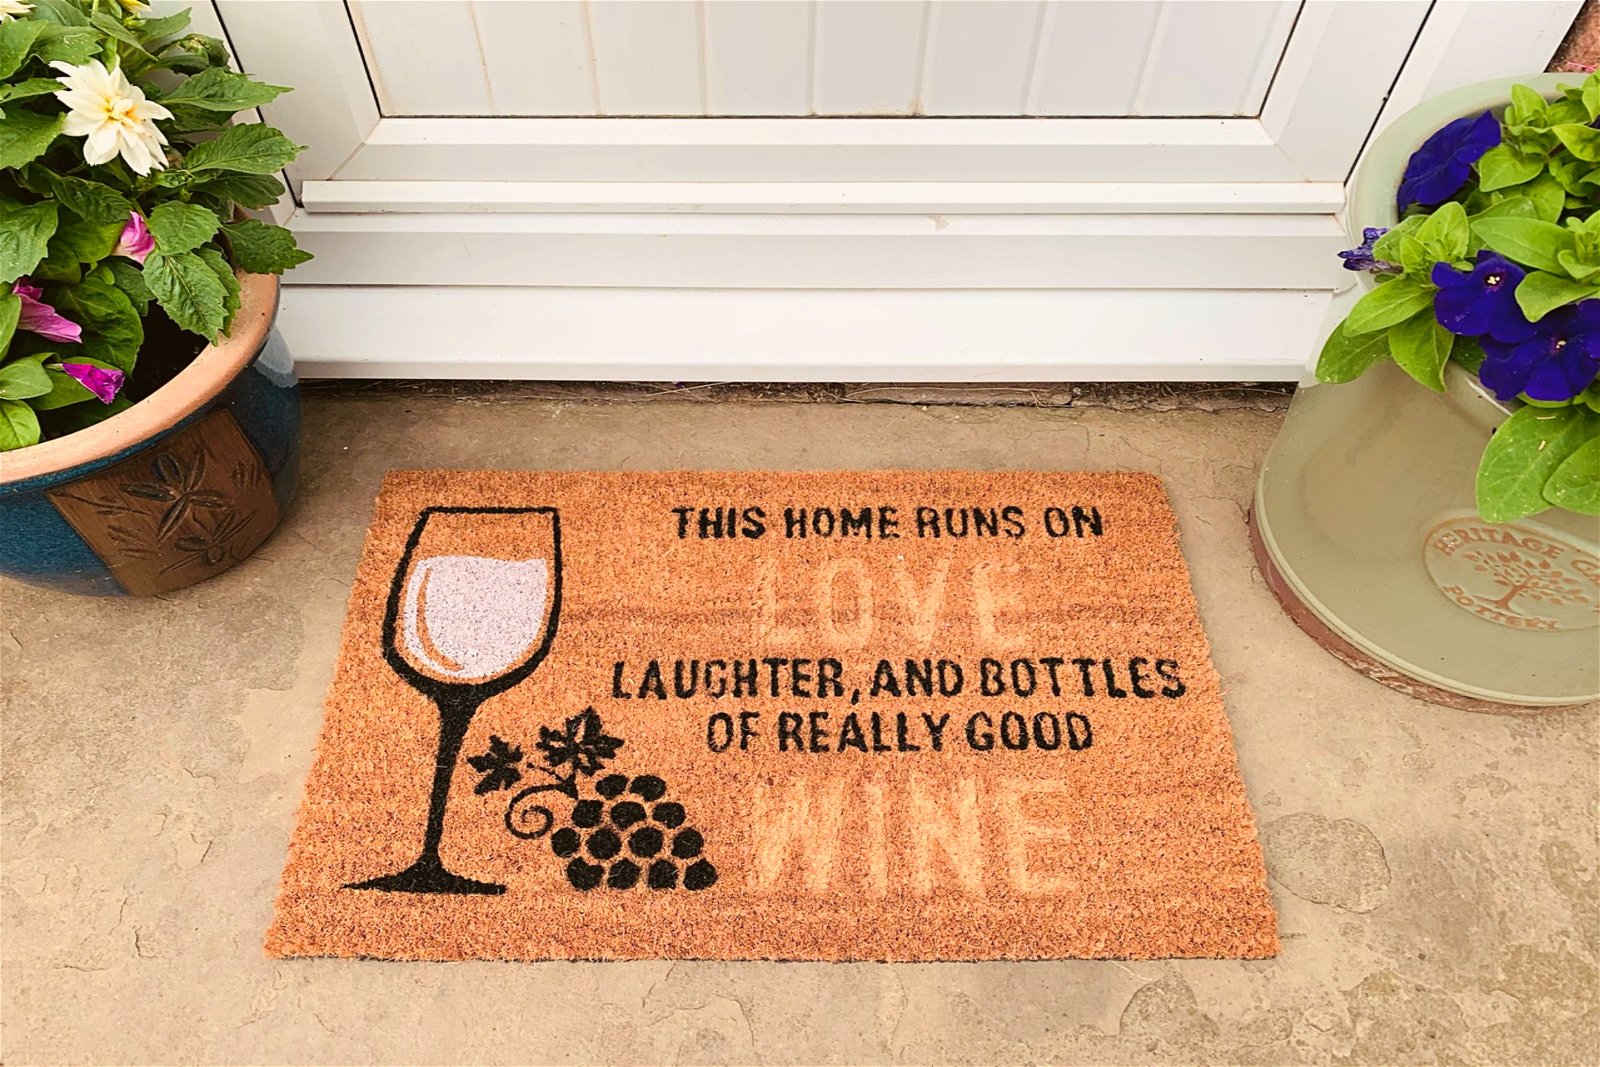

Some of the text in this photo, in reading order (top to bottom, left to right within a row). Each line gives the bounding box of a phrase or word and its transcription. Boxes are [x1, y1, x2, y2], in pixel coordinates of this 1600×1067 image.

[671, 505, 1104, 540] THIS HOME RUNS ON
[1433, 527, 1565, 558] HERITAGE
[755, 556, 1028, 650] LOVE
[1442, 585, 1558, 631] POTTERY
[612, 656, 1187, 705] LAUGHTER, AND BOTTLES
[707, 711, 1093, 753] OF REALLY GOOD
[742, 775, 1076, 898] WINE
